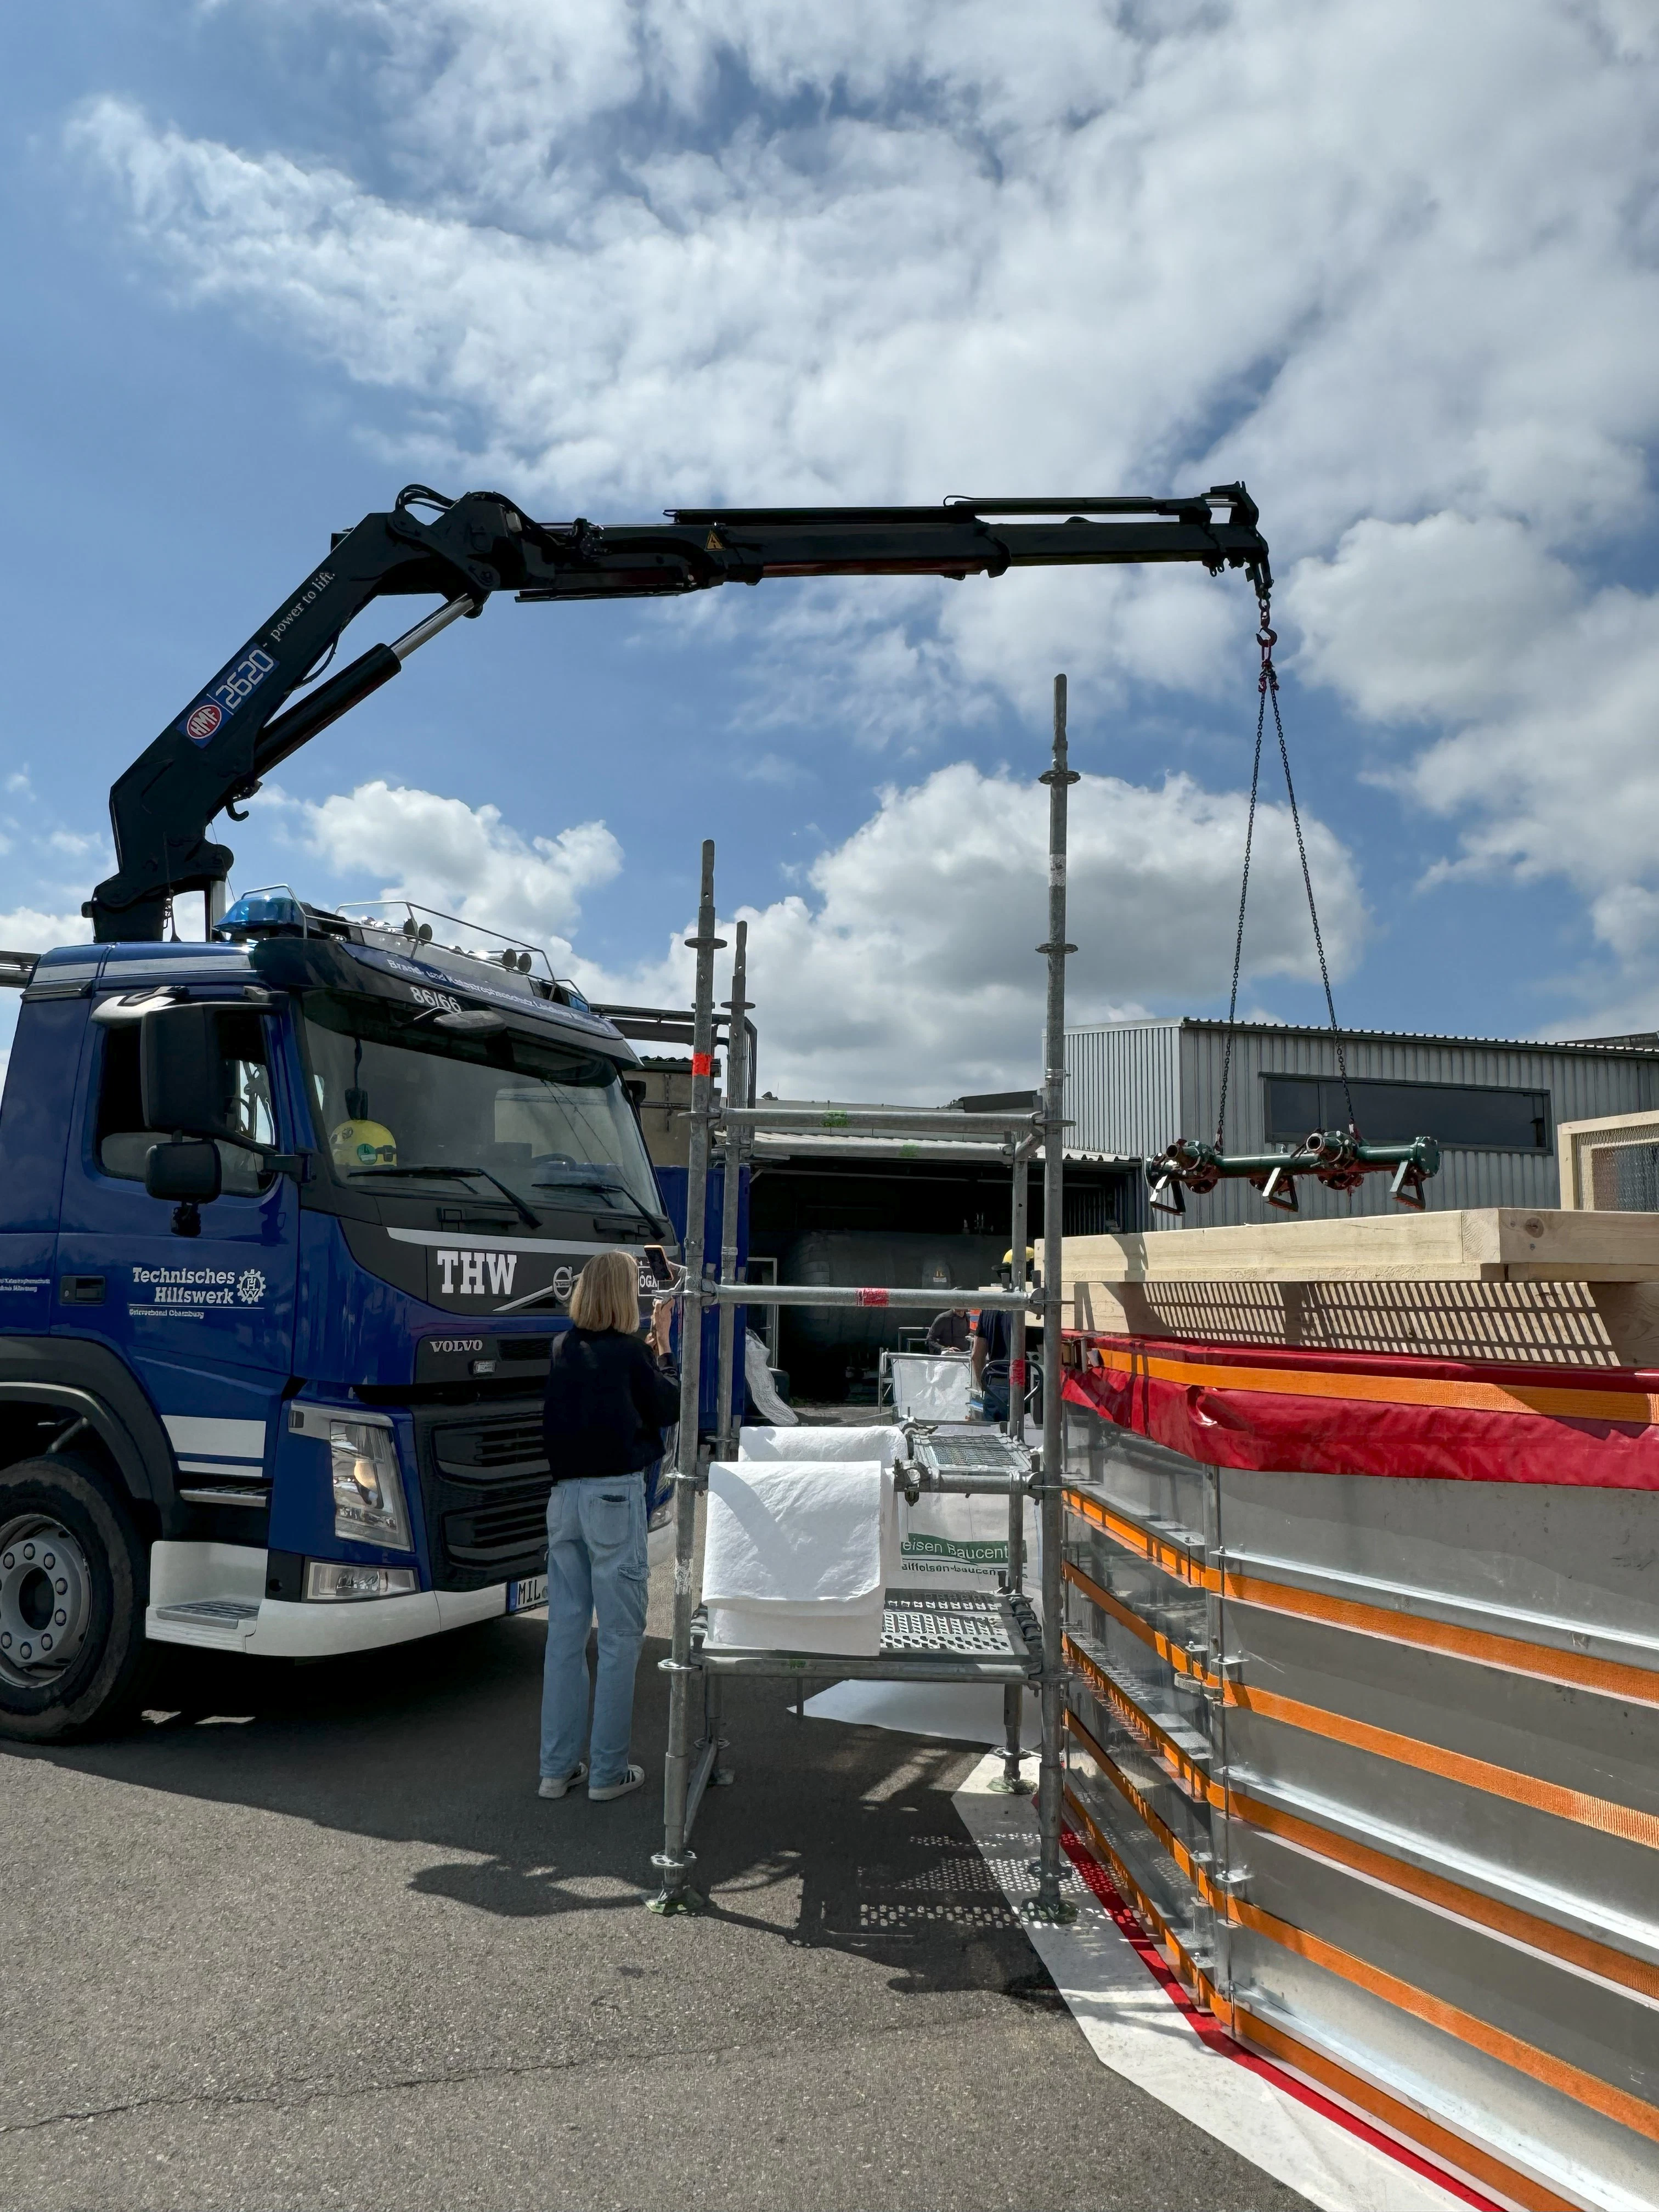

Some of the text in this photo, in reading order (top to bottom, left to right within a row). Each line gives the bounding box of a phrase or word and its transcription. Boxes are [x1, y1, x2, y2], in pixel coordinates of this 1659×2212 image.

[270, 602, 304, 642] power
[302, 591, 317, 603] to
[312, 572, 335, 591] lift.
[190, 650, 274, 736] HMF 2620
[410, 986, 462, 1014] 86/66
[132, 1267, 235, 1284] Technisches
[437, 1250, 517, 1295] THW
[154, 1286, 234, 1304] Hilfswerk
[430, 1339, 483, 1353] VOLVO
[902, 1538, 1008, 1560] eisen Baucent
[518, 1579, 541, 1606] MIL
